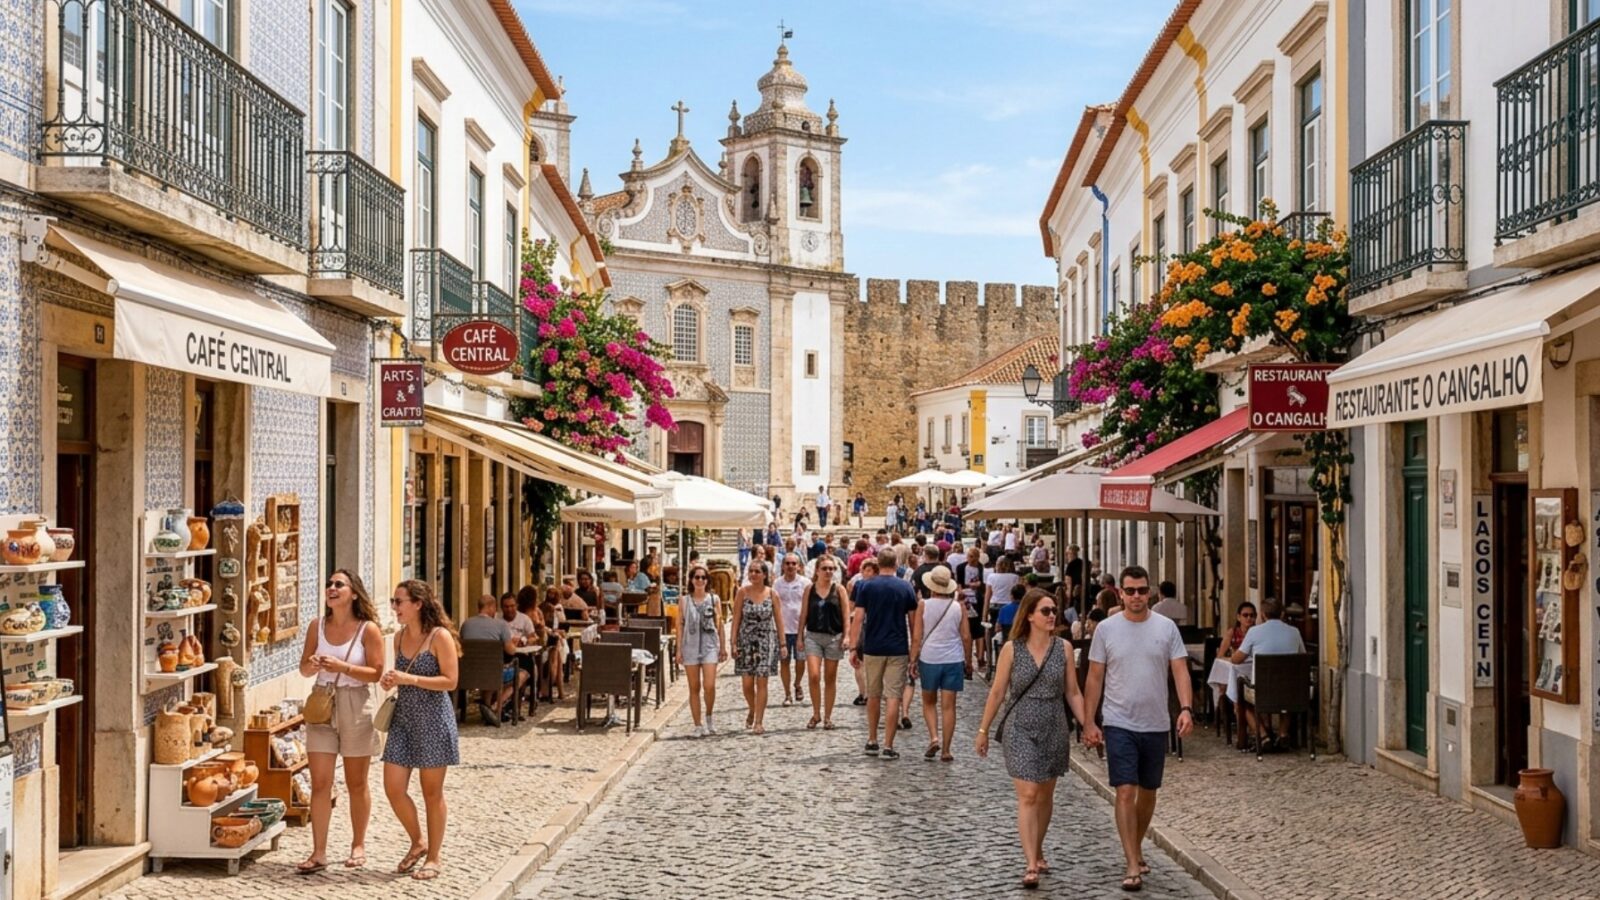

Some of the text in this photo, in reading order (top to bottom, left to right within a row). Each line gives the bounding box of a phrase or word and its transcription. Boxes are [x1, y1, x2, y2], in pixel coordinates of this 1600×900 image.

[463, 325, 497, 344] CAFÉ
[186, 331, 291, 383] CAFÉ CENTRAL
[451, 347, 511, 362] CENTRAL
[1335, 354, 1529, 422] RESTAURANTE O CANGALHO
[1253, 412, 1263, 426] O
[1475, 500, 1491, 678] LAGOS CETN
